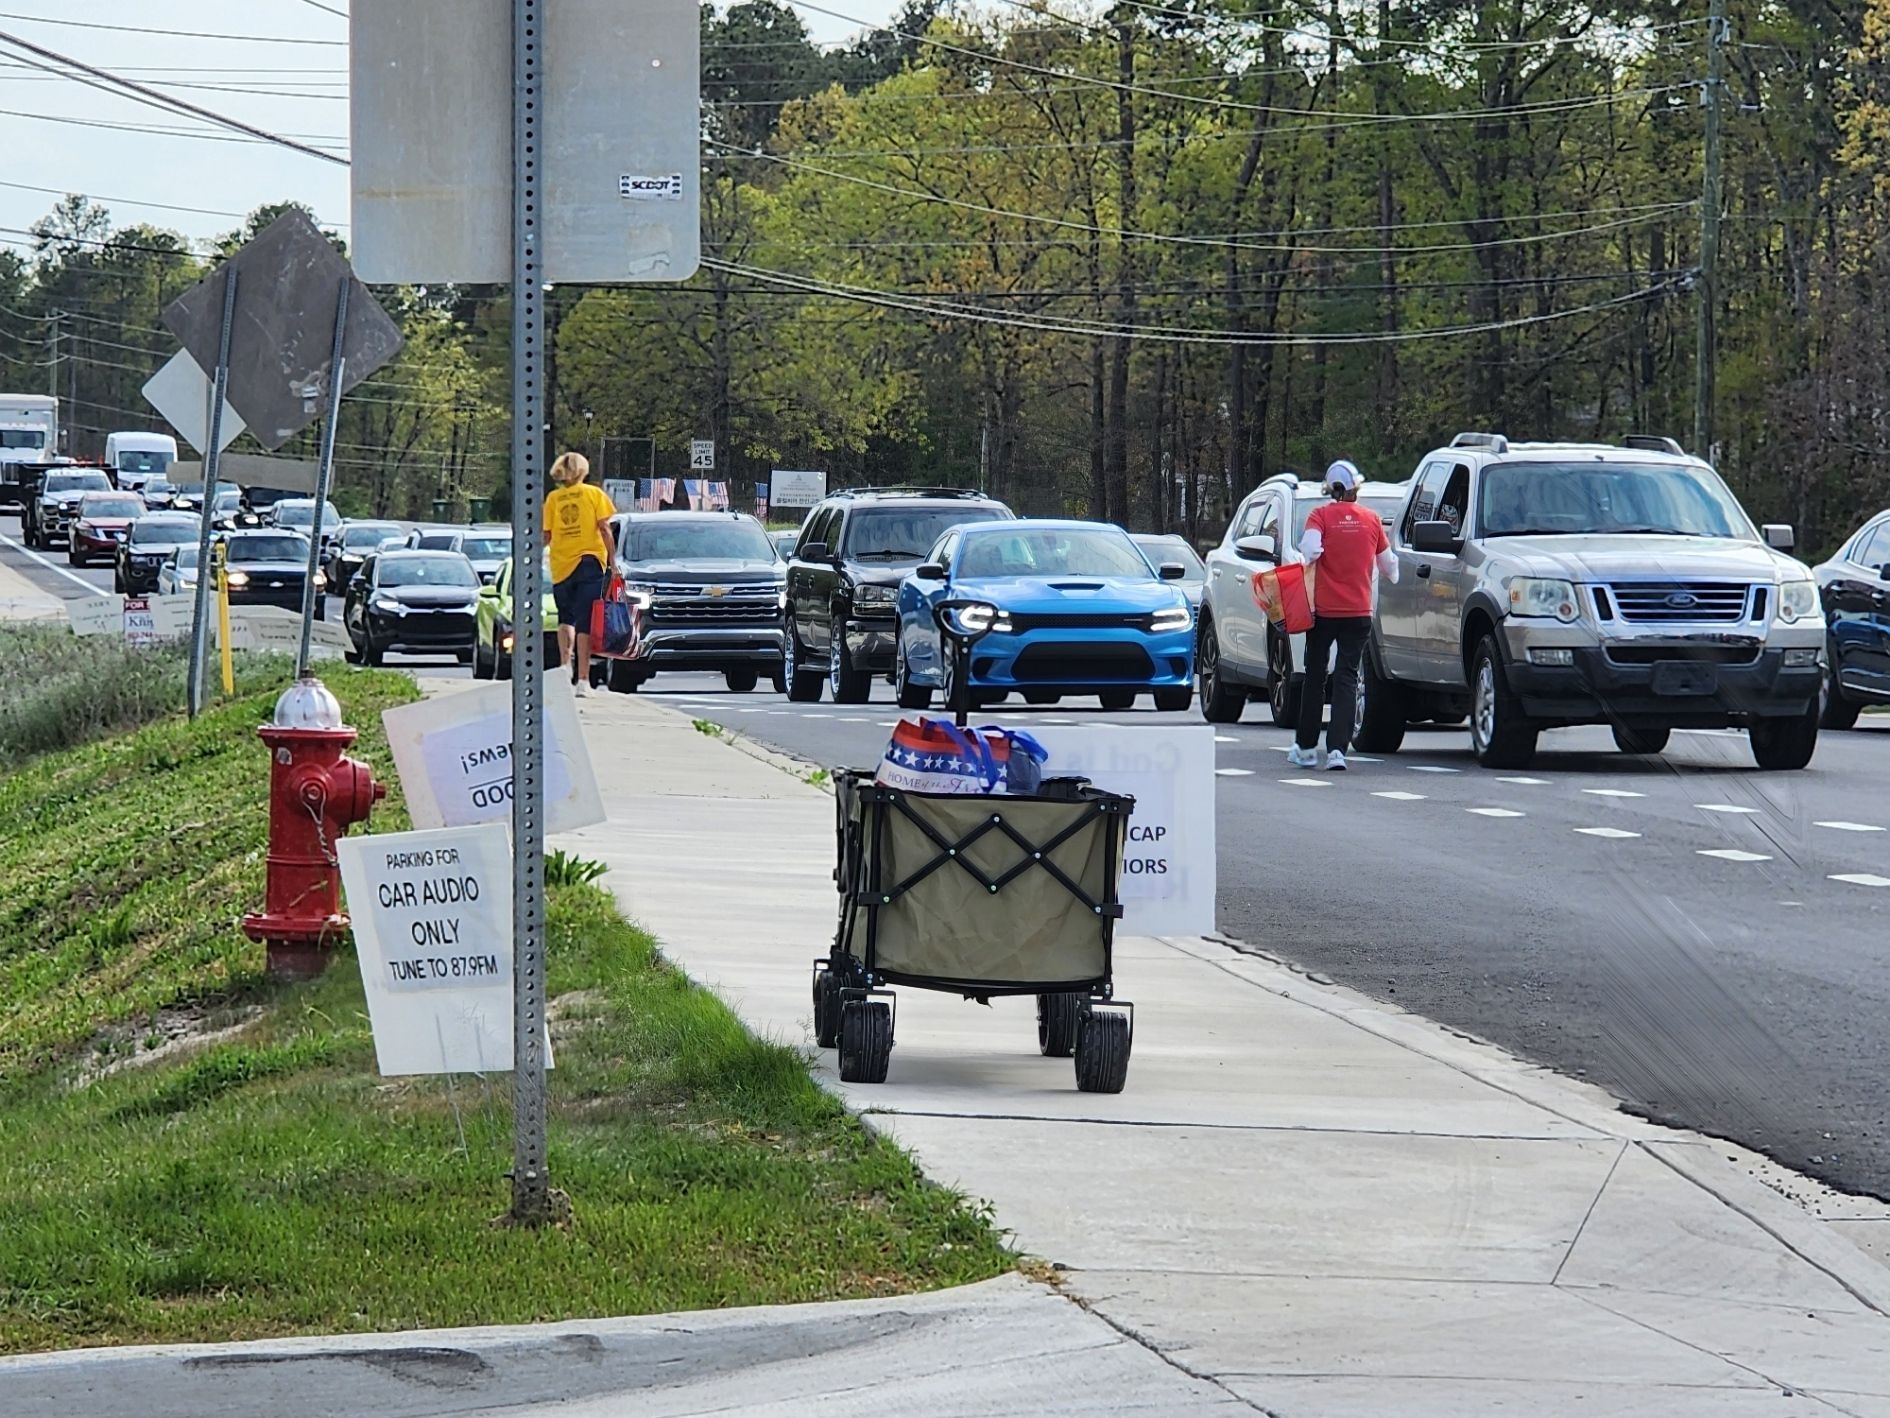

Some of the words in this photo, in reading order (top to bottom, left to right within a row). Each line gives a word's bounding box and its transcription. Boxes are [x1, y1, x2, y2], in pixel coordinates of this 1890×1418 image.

[693, 455, 713, 466] 45
[125, 601, 145, 610] FOR
[460, 743, 513, 775] ews!
[887, 771, 920, 789] HOME
[472, 781, 514, 808] OOD
[1125, 826, 1166, 842] CAP
[386, 851, 433, 870] PARKING
[436, 849, 460, 866] FOR
[1123, 858, 1168, 875] IORS
[378, 883, 418, 909] CAR
[423, 876, 479, 905] AUDIO
[411, 919, 460, 946] ONLY
[389, 961, 427, 981] TUNE
[427, 958, 448, 978] TO
[451, 955, 498, 977] 87.9FM
